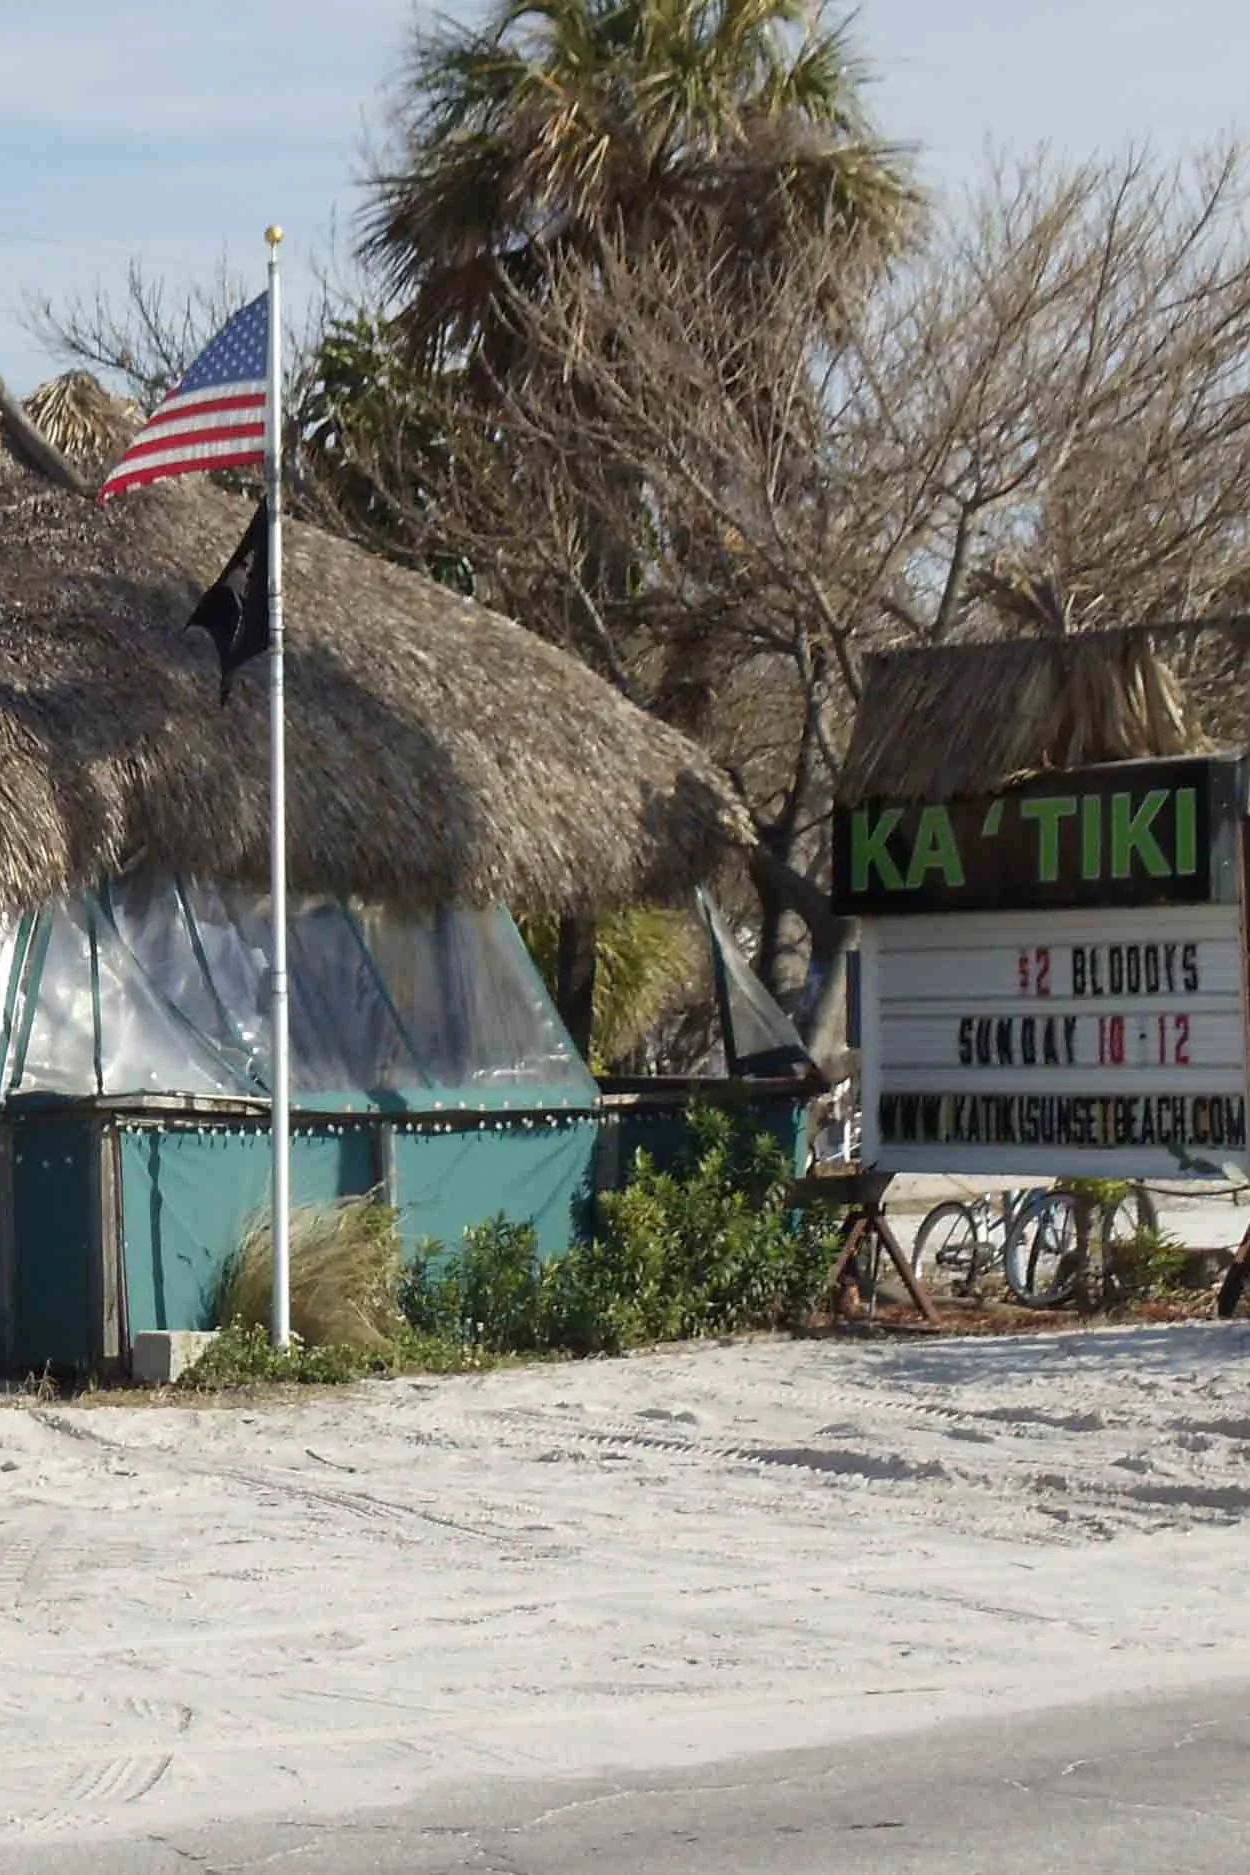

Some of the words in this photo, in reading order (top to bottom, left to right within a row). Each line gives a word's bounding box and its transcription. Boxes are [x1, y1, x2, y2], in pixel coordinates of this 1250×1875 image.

[1018, 946, 1050, 996] $2
[1072, 943, 1198, 995] BLOODYS
[958, 1015, 1077, 1065] SUNDAY
[1099, 1014, 1126, 1065] 10
[1158, 1012, 1191, 1065] 12
